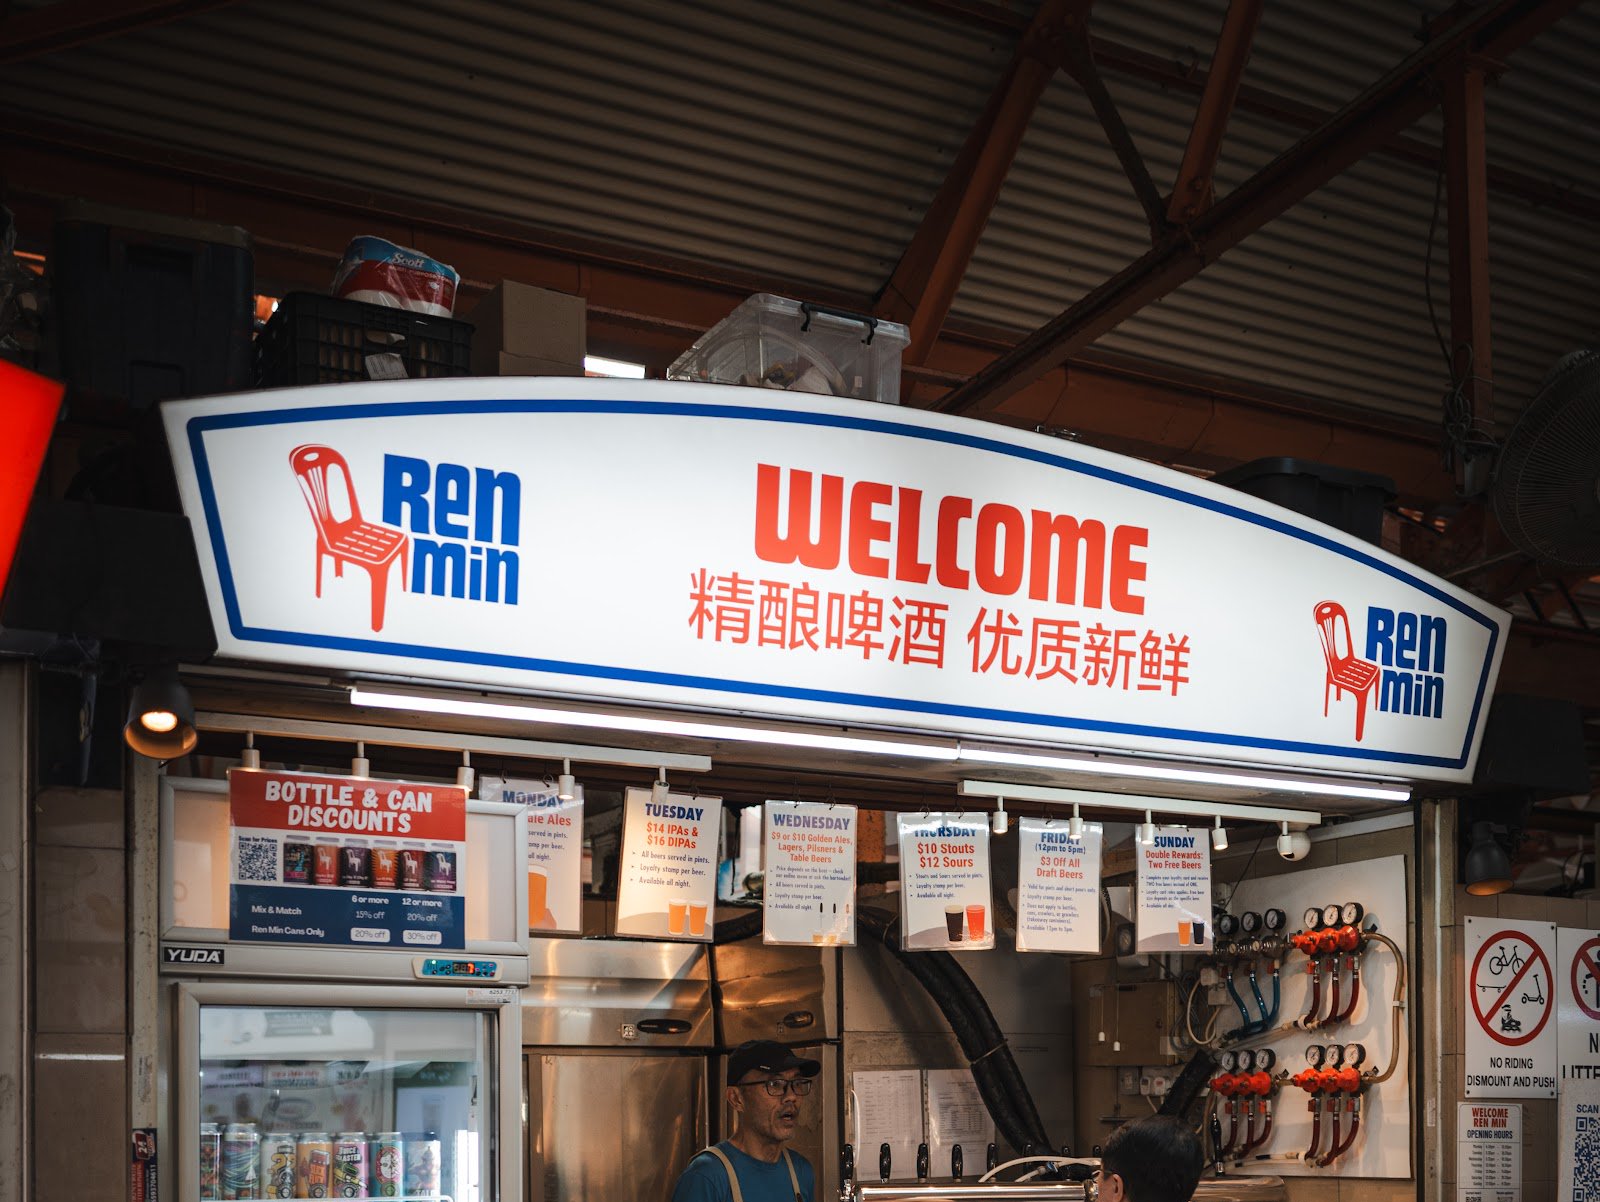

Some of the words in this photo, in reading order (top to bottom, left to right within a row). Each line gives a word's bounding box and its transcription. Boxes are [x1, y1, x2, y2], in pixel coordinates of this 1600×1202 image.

[392, 252, 425, 269] Scott
[383, 453, 521, 546] Ren
[755, 463, 1149, 615] WELCOME
[411, 538, 519, 605] min
[688, 567, 948, 668] 精酿啤酒
[967, 607, 1191, 697] 优质新鲜
[1365, 606, 1447, 674] Ren
[1380, 669, 1444, 719] min
[265, 781, 354, 807] BOTTLE
[362, 788, 378, 809] &
[387, 790, 433, 813] CAN
[645, 803, 704, 821] TUESDAY
[288, 804, 412, 833] DISCOUNTS
[528, 813, 543, 824] ale
[547, 814, 572, 826] Ales
[773, 813, 850, 830] WEDNESDAY
[646, 822, 665, 834] $14
[667, 825, 689, 836] IPAs
[691, 826, 699, 836] &
[914, 825, 976, 838] THURSDAY
[647, 834, 665, 846] $16
[668, 837, 697, 849] DIPAs
[771, 832, 781, 841] $9
[792, 832, 806, 842] $10
[808, 833, 833, 843] Golden
[834, 835, 853, 845] Ales,
[1154, 836, 1195, 848] SUNDAY
[551, 842, 565, 850] beer.
[778, 843, 805, 853] Lagers,
[807, 844, 836, 854] Pilsners
[838, 845, 844, 853] &
[917, 843, 937, 855] $10
[940, 843, 975, 854] Stouts
[1035, 843, 1058, 853] (12pm
[1059, 845, 1066, 853] to
[1067, 846, 1086, 855] 5pm)
[536, 853, 551, 861] night.
[650, 851, 666, 860] beers
[668, 853, 686, 862] served
[694, 855, 710, 864] pints.
[790, 854, 809, 863] Table
[811, 855, 832, 863] Beers
[1145, 850, 1170, 859] Double
[1171, 851, 1204, 860] Rewards:
[920, 856, 939, 869] $12
[943, 857, 974, 868] Sours
[1040, 856, 1051, 867] $3
[1053, 857, 1066, 867] Off
[1068, 858, 1080, 868] All
[1148, 860, 1163, 869] Two
[1164, 861, 1180, 869] Free
[1181, 861, 1202, 869] Beers
[640, 864, 661, 873] Loyalty
[662, 866, 680, 875] stamp
[681, 867, 690, 876] per
[691, 867, 706, 876] beer.
[1036, 867, 1057, 878] Draft
[1059, 868, 1083, 880] Beers
[638, 876, 665, 886] Available
[674, 878, 691, 888] night.
[351, 895, 357, 903] 6
[368, 897, 389, 905] more
[402, 897, 411, 906] 12
[251, 905, 267, 913] Mix
[268, 906, 274, 914] &
[275, 906, 302, 915] Match
[355, 910, 372, 919] 15%
[373, 911, 385, 919] off
[407, 912, 425, 921] 20%
[251, 925, 268, 933] Ren
[268, 926, 284, 934] Min
[284, 926, 305, 935] Cans
[306, 928, 325, 937] Only
[355, 929, 373, 938] 20%
[374, 930, 386, 938] off
[407, 932, 425, 940] 30%
[426, 932, 438, 940] off
[167, 949, 221, 963] YUDA
[1490, 1056, 1503, 1069] NO
[1504, 1057, 1533, 1070] RIDING
[1467, 1074, 1511, 1088] DISMOUNT
[1513, 1076, 1531, 1088] AND
[1532, 1076, 1555, 1088] PUSH
[1472, 1107, 1509, 1118] WELCOME
[1576, 1104, 1599, 1114] SCAN
[1473, 1118, 1489, 1128] REN
[1491, 1118, 1507, 1128] MIN
[1467, 1130, 1493, 1139] OPENING
[1494, 1130, 1513, 1139] HOURS
